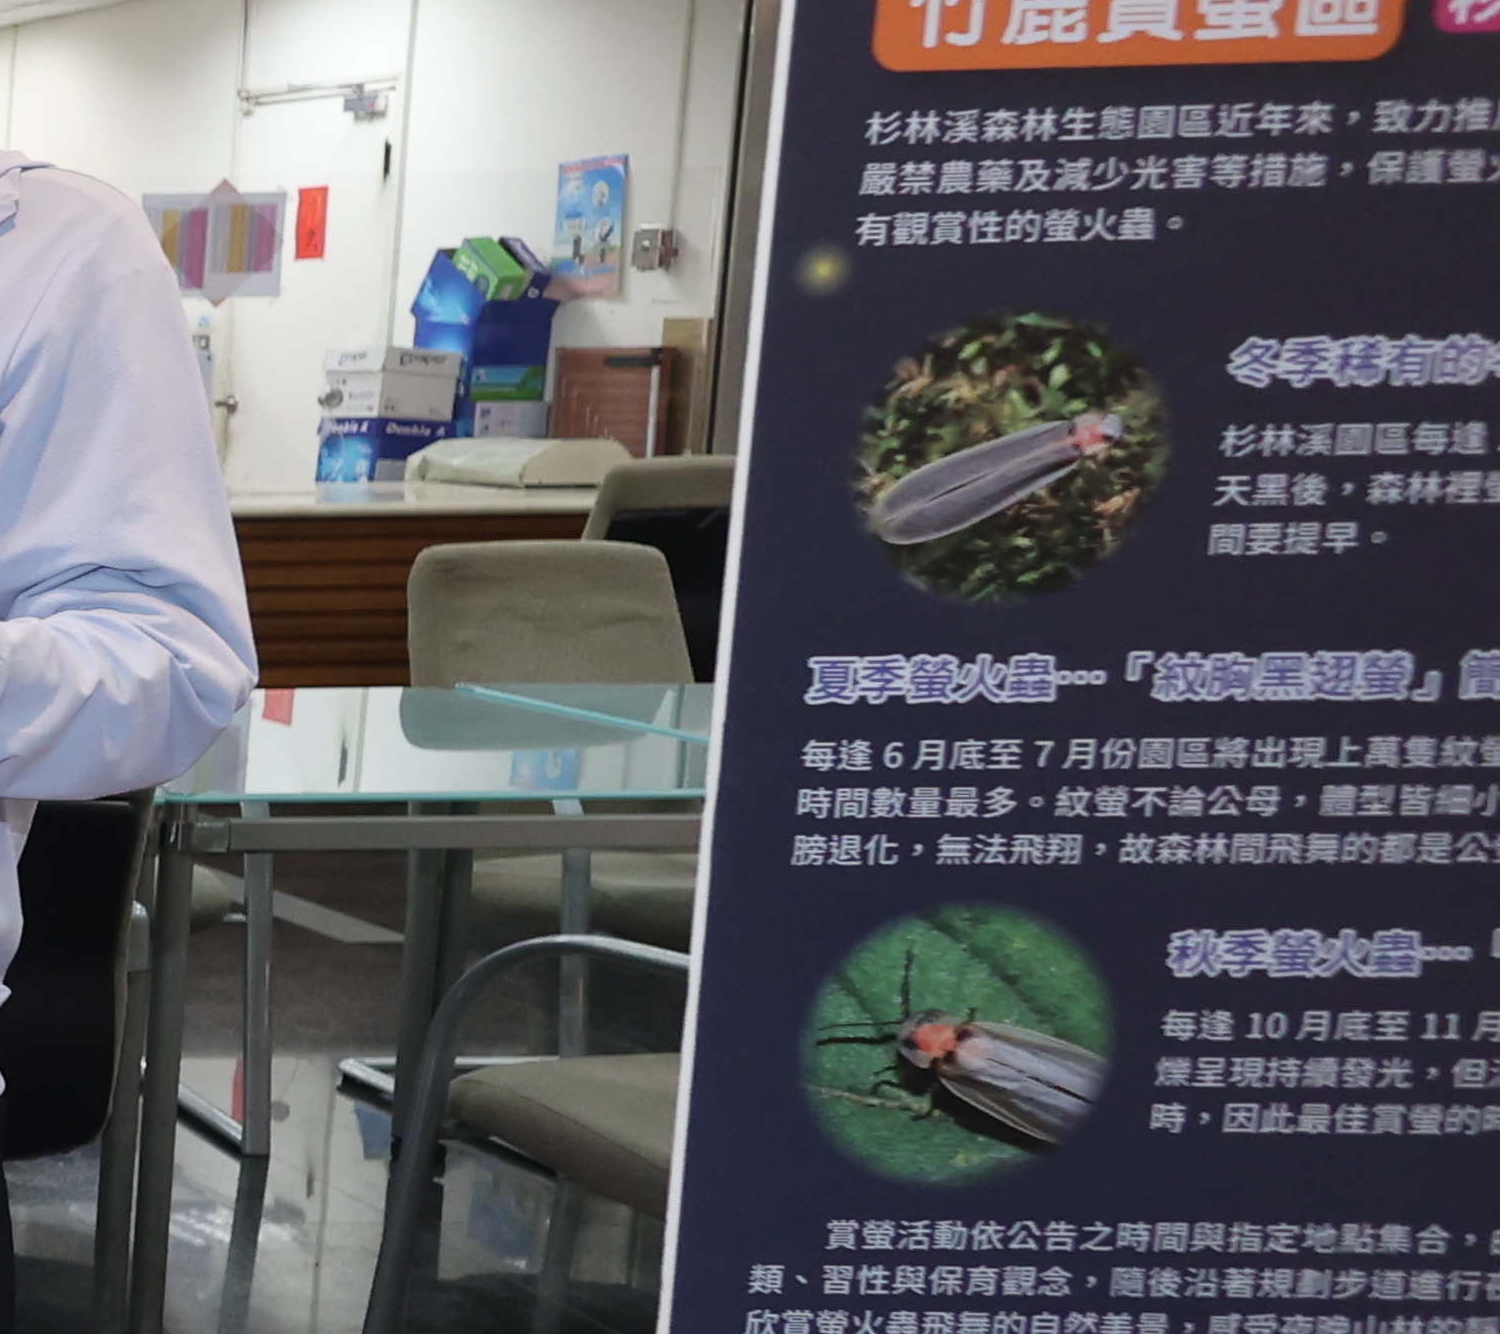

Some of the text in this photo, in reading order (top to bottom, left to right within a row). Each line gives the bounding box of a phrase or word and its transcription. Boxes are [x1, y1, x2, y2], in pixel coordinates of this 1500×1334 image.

[1226, 333, 1500, 389] 冬季稀有的
[801, 739, 874, 773] 每逢
[881, 741, 904, 770] 6
[912, 739, 1025, 772] 月底至
[1033, 741, 1057, 770] 7
[1244, 1011, 1290, 1041] 10
[1420, 1011, 1461, 1041] 11
